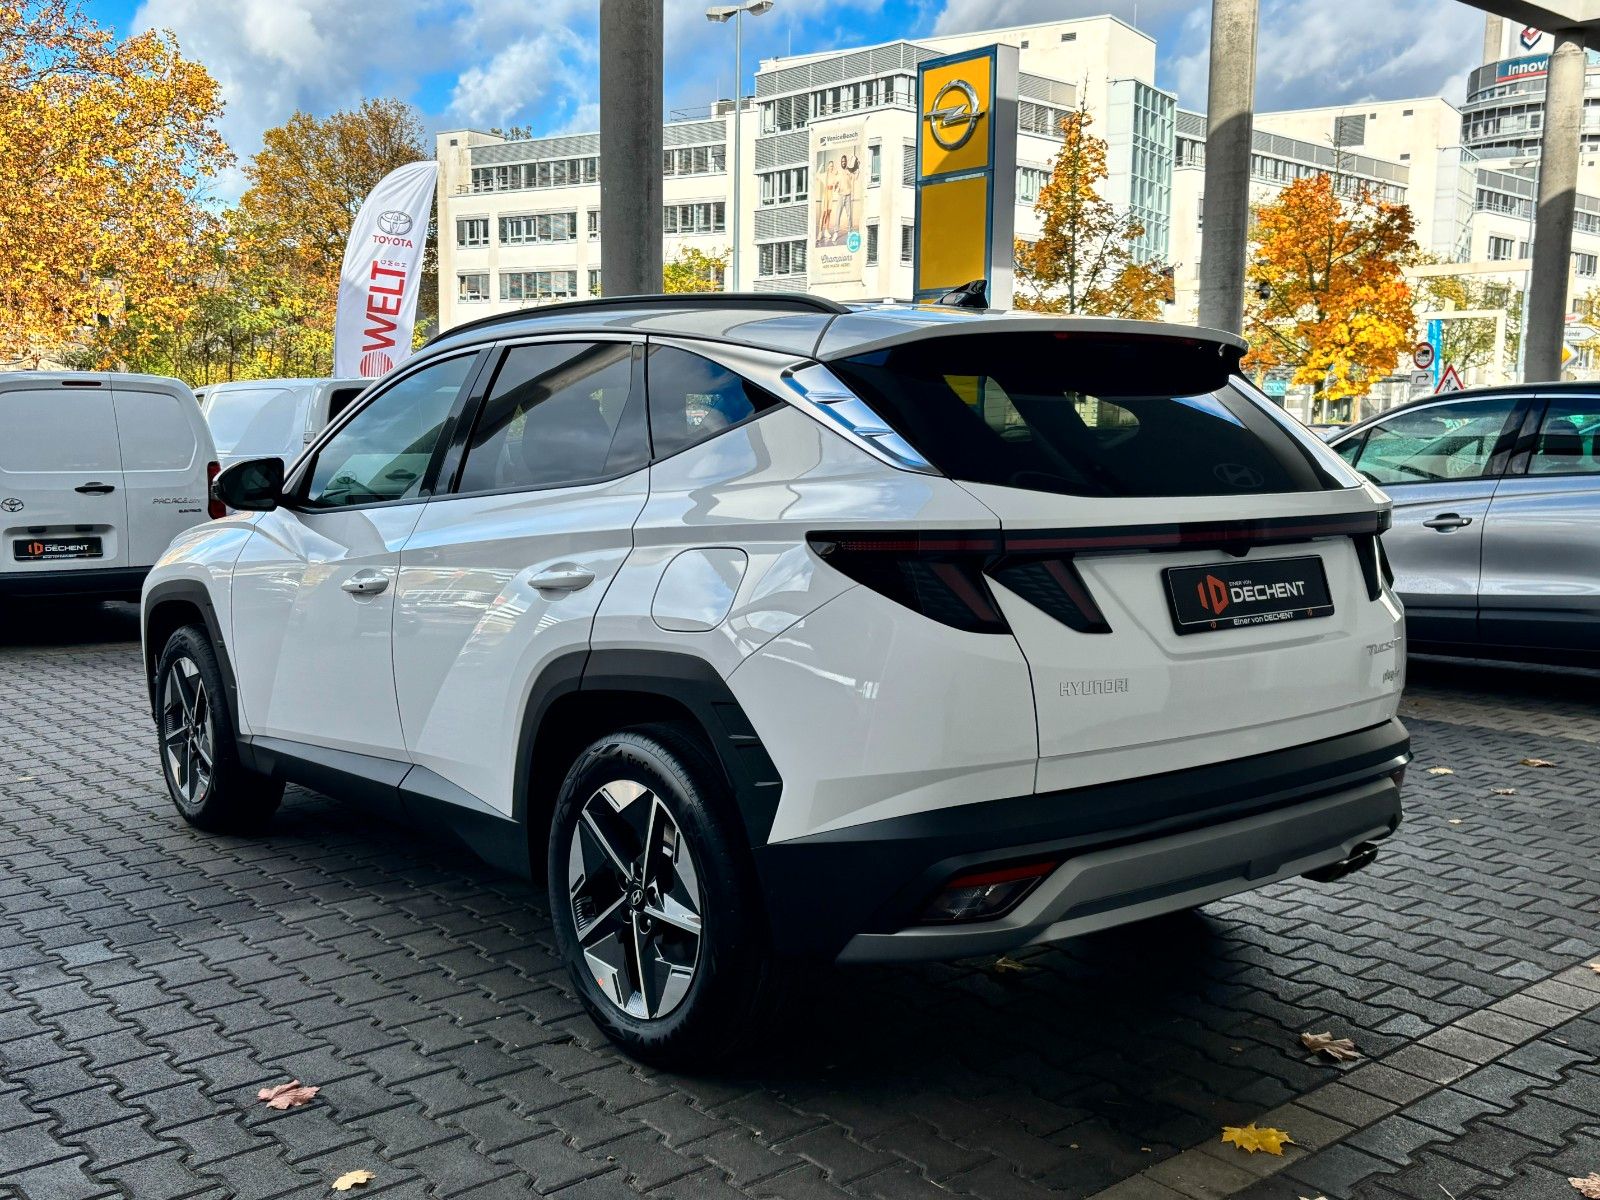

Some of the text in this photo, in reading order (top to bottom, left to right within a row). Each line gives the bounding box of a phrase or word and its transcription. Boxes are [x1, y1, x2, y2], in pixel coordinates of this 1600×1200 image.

[373, 235, 413, 249] TOYOTA
[362, 260, 406, 352] WELT
[45, 544, 89, 552] DECHENT
[1230, 581, 1305, 603] DECHENT
[1233, 618, 1250, 626] Einer
[1264, 611, 1294, 622] DECHENT
[1059, 677, 1129, 697] HYUNDAI
